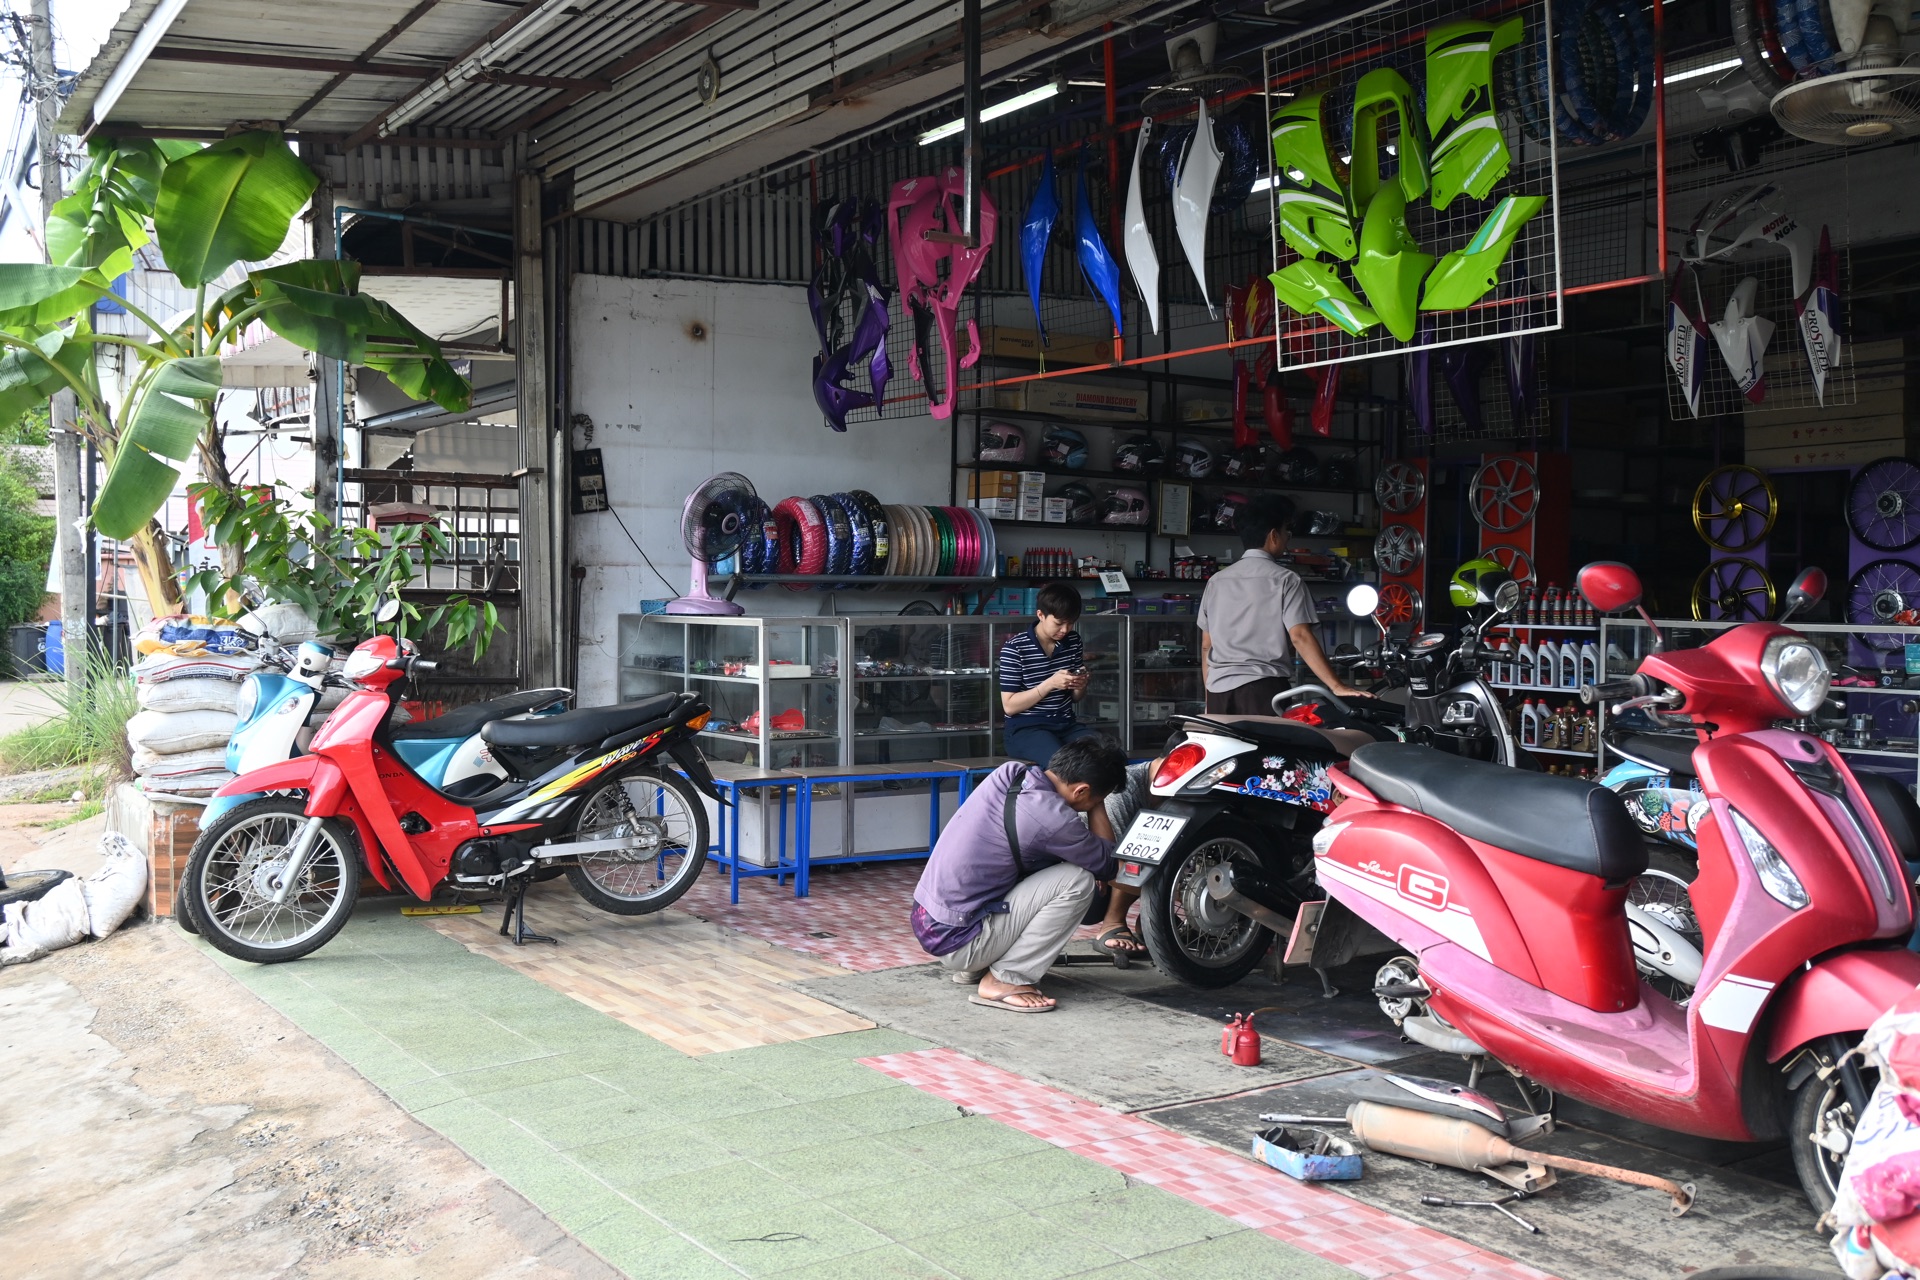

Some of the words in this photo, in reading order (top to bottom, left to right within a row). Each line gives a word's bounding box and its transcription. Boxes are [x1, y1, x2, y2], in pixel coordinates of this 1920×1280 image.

[1463, 142, 1500, 190] Racing
[1762, 214, 1789, 236] MOTUL
[1774, 220, 1798, 241] NGK
[1075, 393, 1105, 405] DIAMOND
[1105, 395, 1138, 407] DISCOVERY
[1122, 842, 1160, 860] 8602
